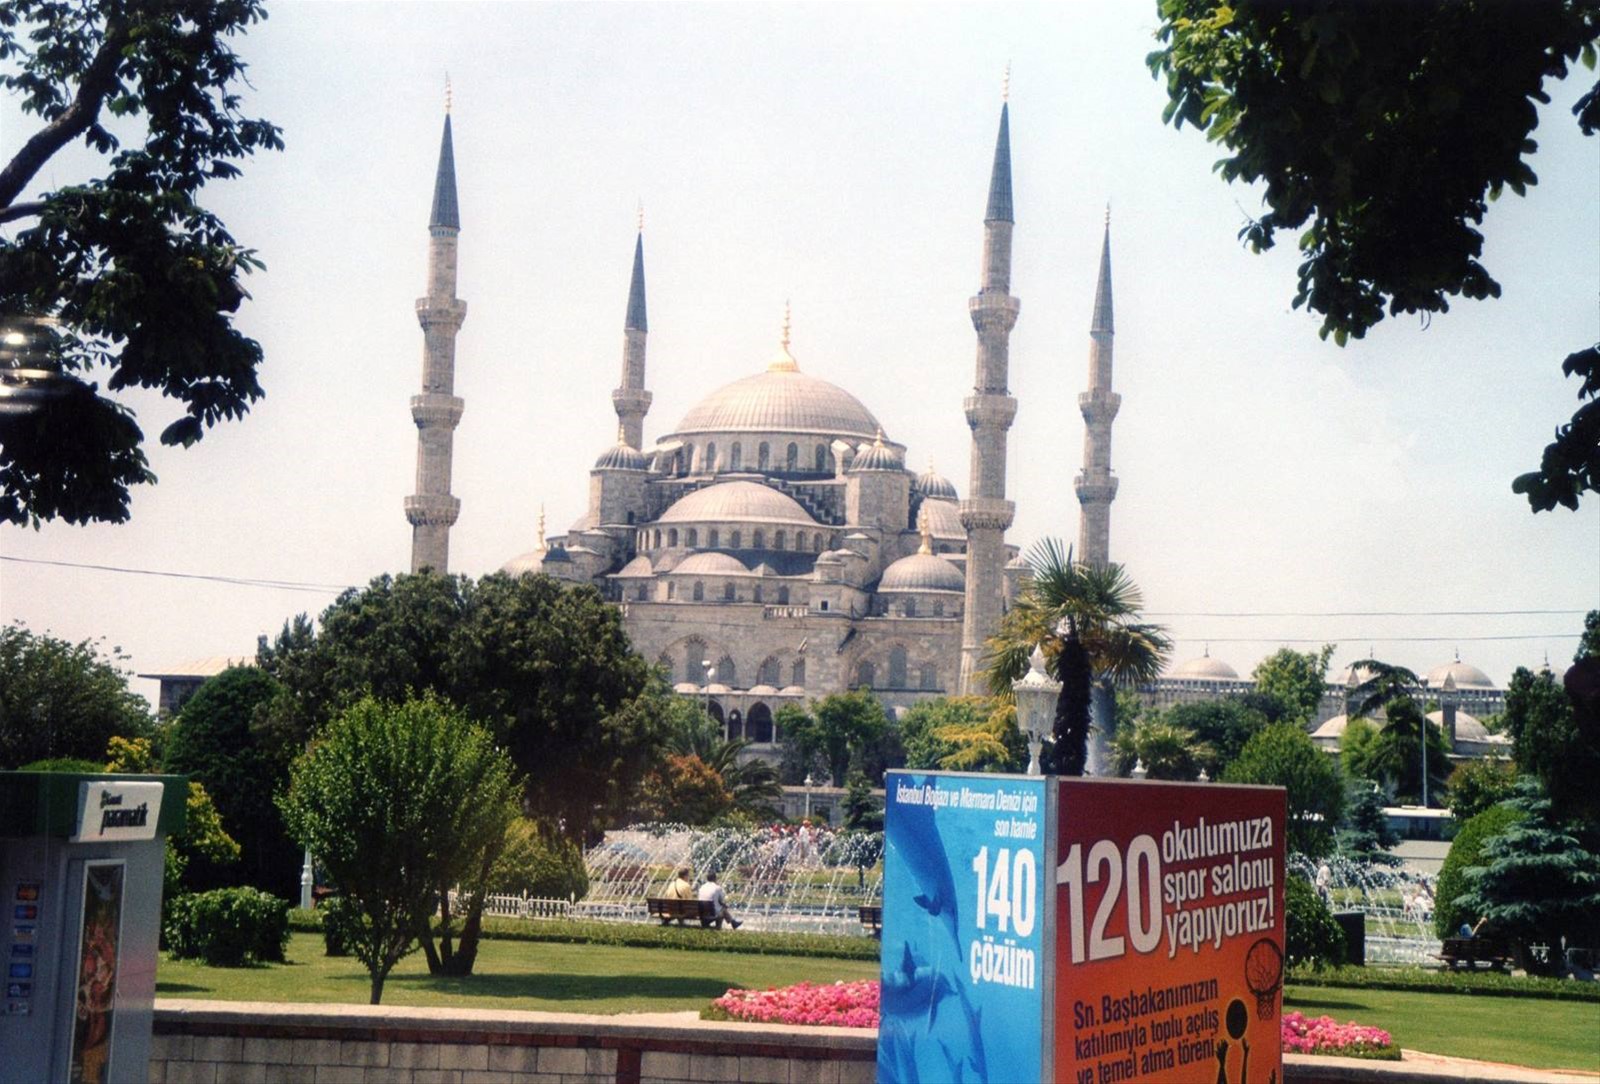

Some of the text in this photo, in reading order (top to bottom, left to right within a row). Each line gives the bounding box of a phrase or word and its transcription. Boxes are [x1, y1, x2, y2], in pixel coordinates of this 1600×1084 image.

[950, 789, 959, 807] ve
[960, 787, 995, 810] Marmara
[996, 789, 1020, 811] Denizi
[1022, 791, 1038, 816] için
[994, 817, 1038, 839] son hamle
[1163, 816, 1273, 863] okulumuza
[973, 846, 1036, 937] 140
[1057, 834, 1162, 964] 120
[1164, 855, 1274, 910] spor salonu
[1166, 887, 1275, 959] yapıyoruz!
[970, 935, 1035, 989] çözüm
[1074, 978, 1218, 1030] Sn. Başbakanımızın
[1075, 1007, 1219, 1060] katılımıyla toplu açılış
[1077, 1034, 1215, 1084] ve temel atma töreni
